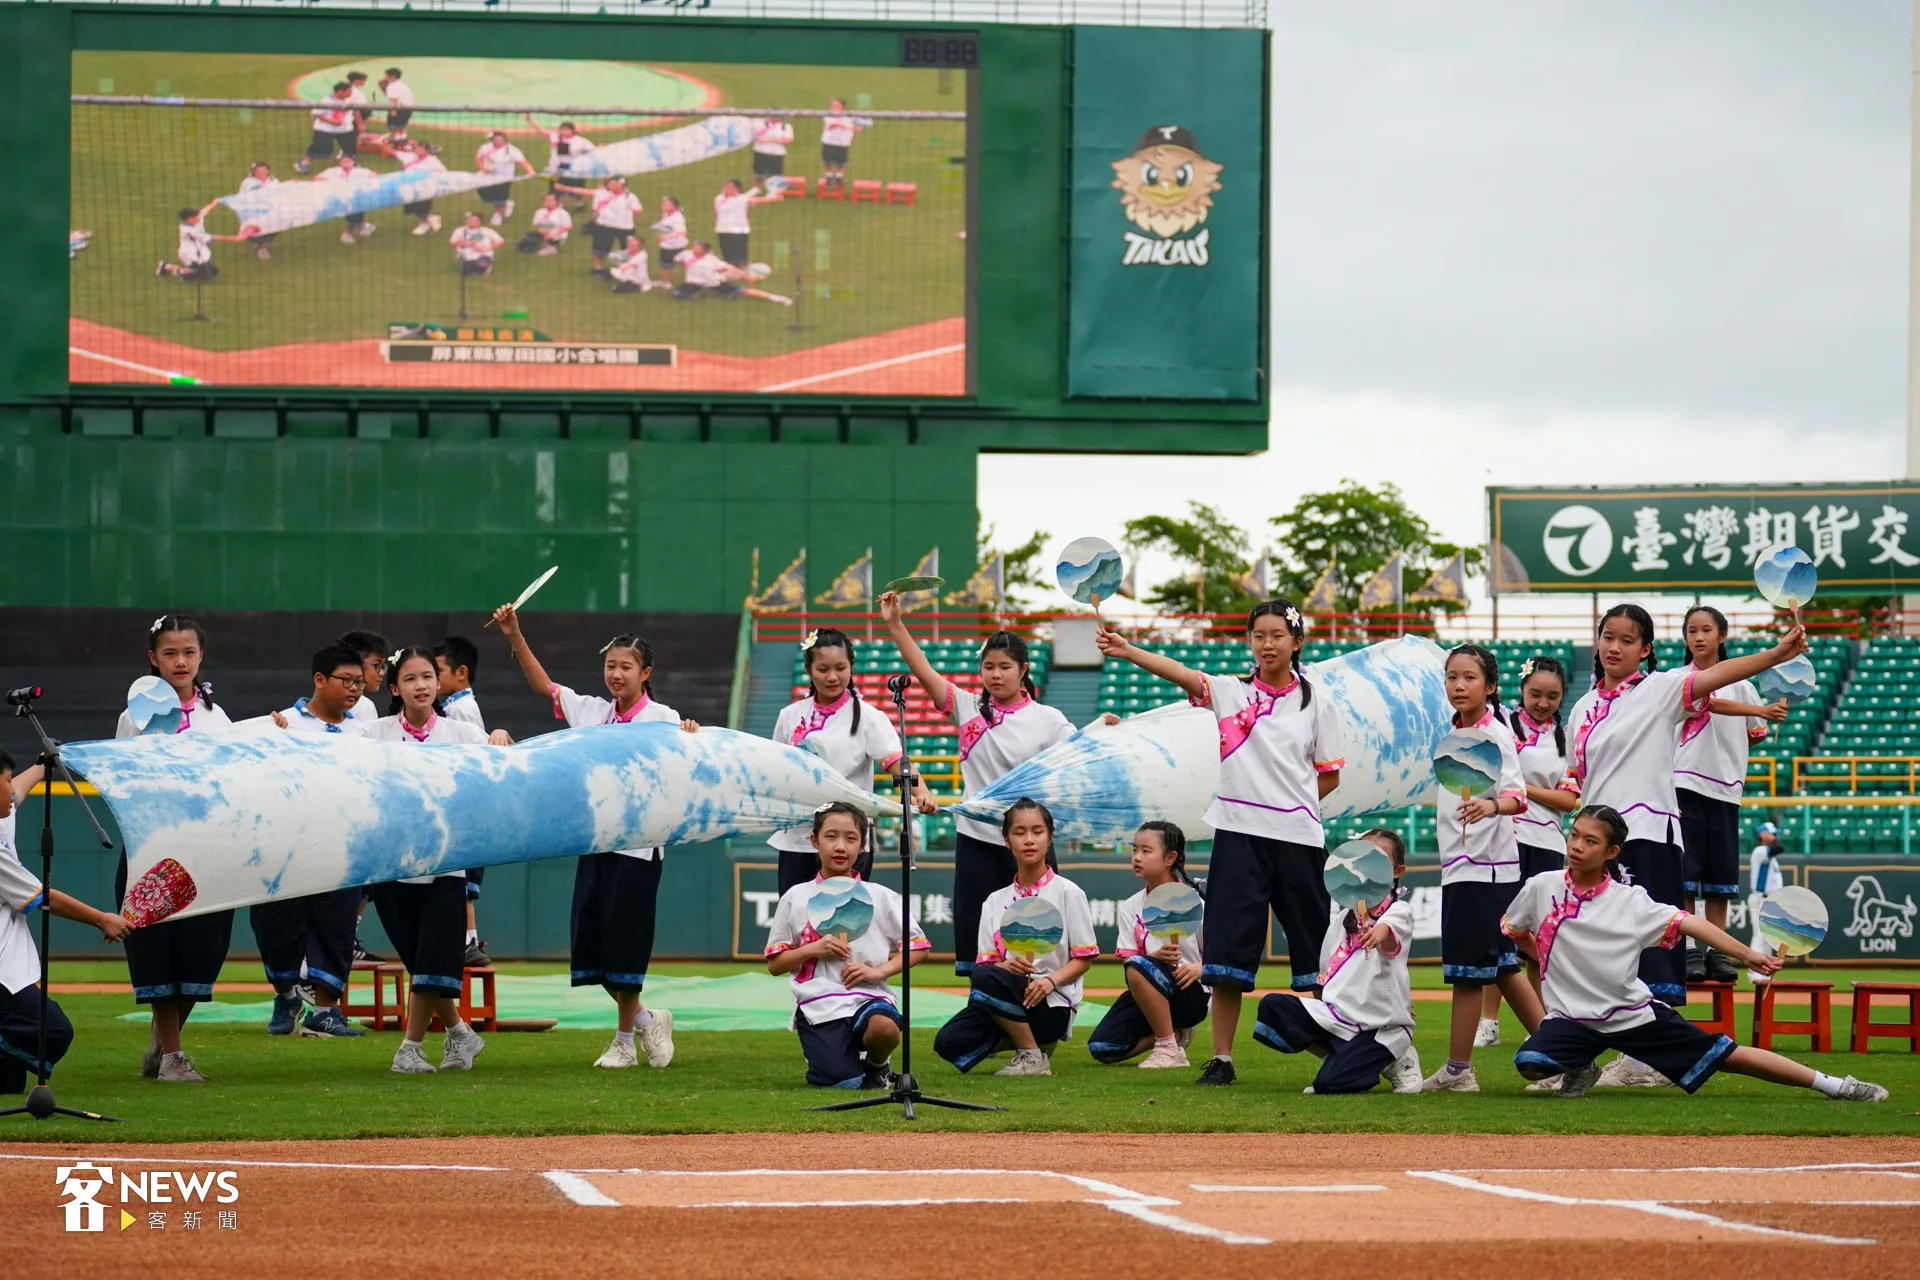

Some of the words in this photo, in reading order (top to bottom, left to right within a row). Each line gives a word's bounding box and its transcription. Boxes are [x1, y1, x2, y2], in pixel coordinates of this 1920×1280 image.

[1622, 504, 1920, 572] 臺灣期貨交
[1860, 938, 1897, 952] LION
